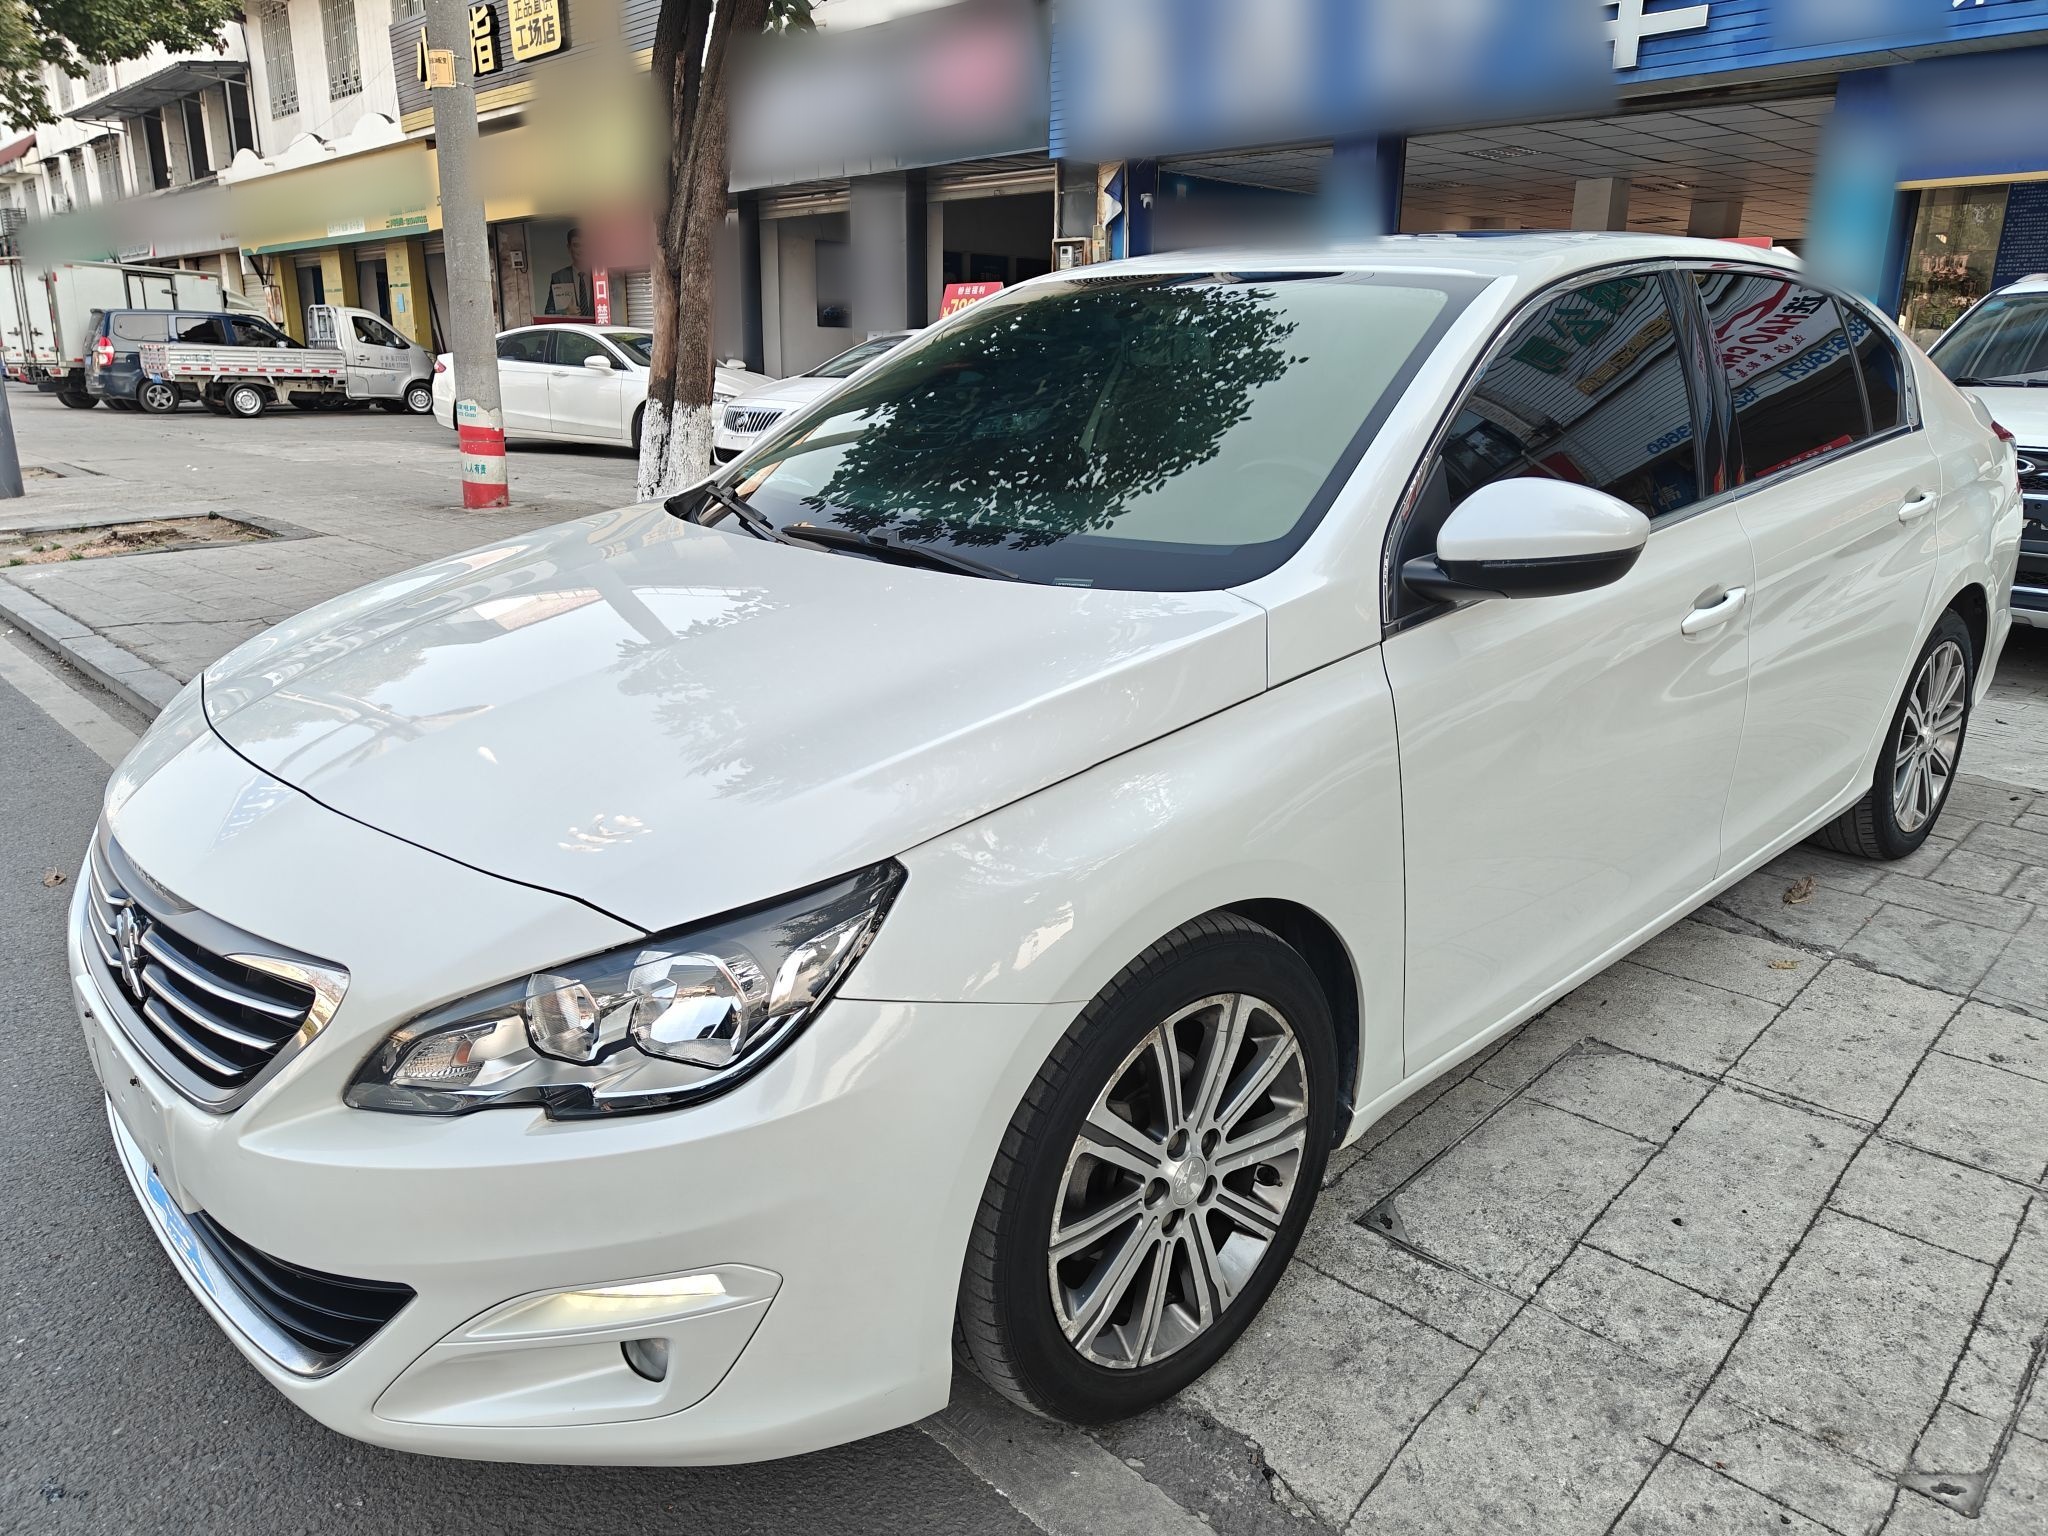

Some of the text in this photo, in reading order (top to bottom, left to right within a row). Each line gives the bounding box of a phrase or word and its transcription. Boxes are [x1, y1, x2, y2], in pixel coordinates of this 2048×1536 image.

[515, 13, 556, 51] 工场店
[957, 285, 986, 295] 粉丝福利
